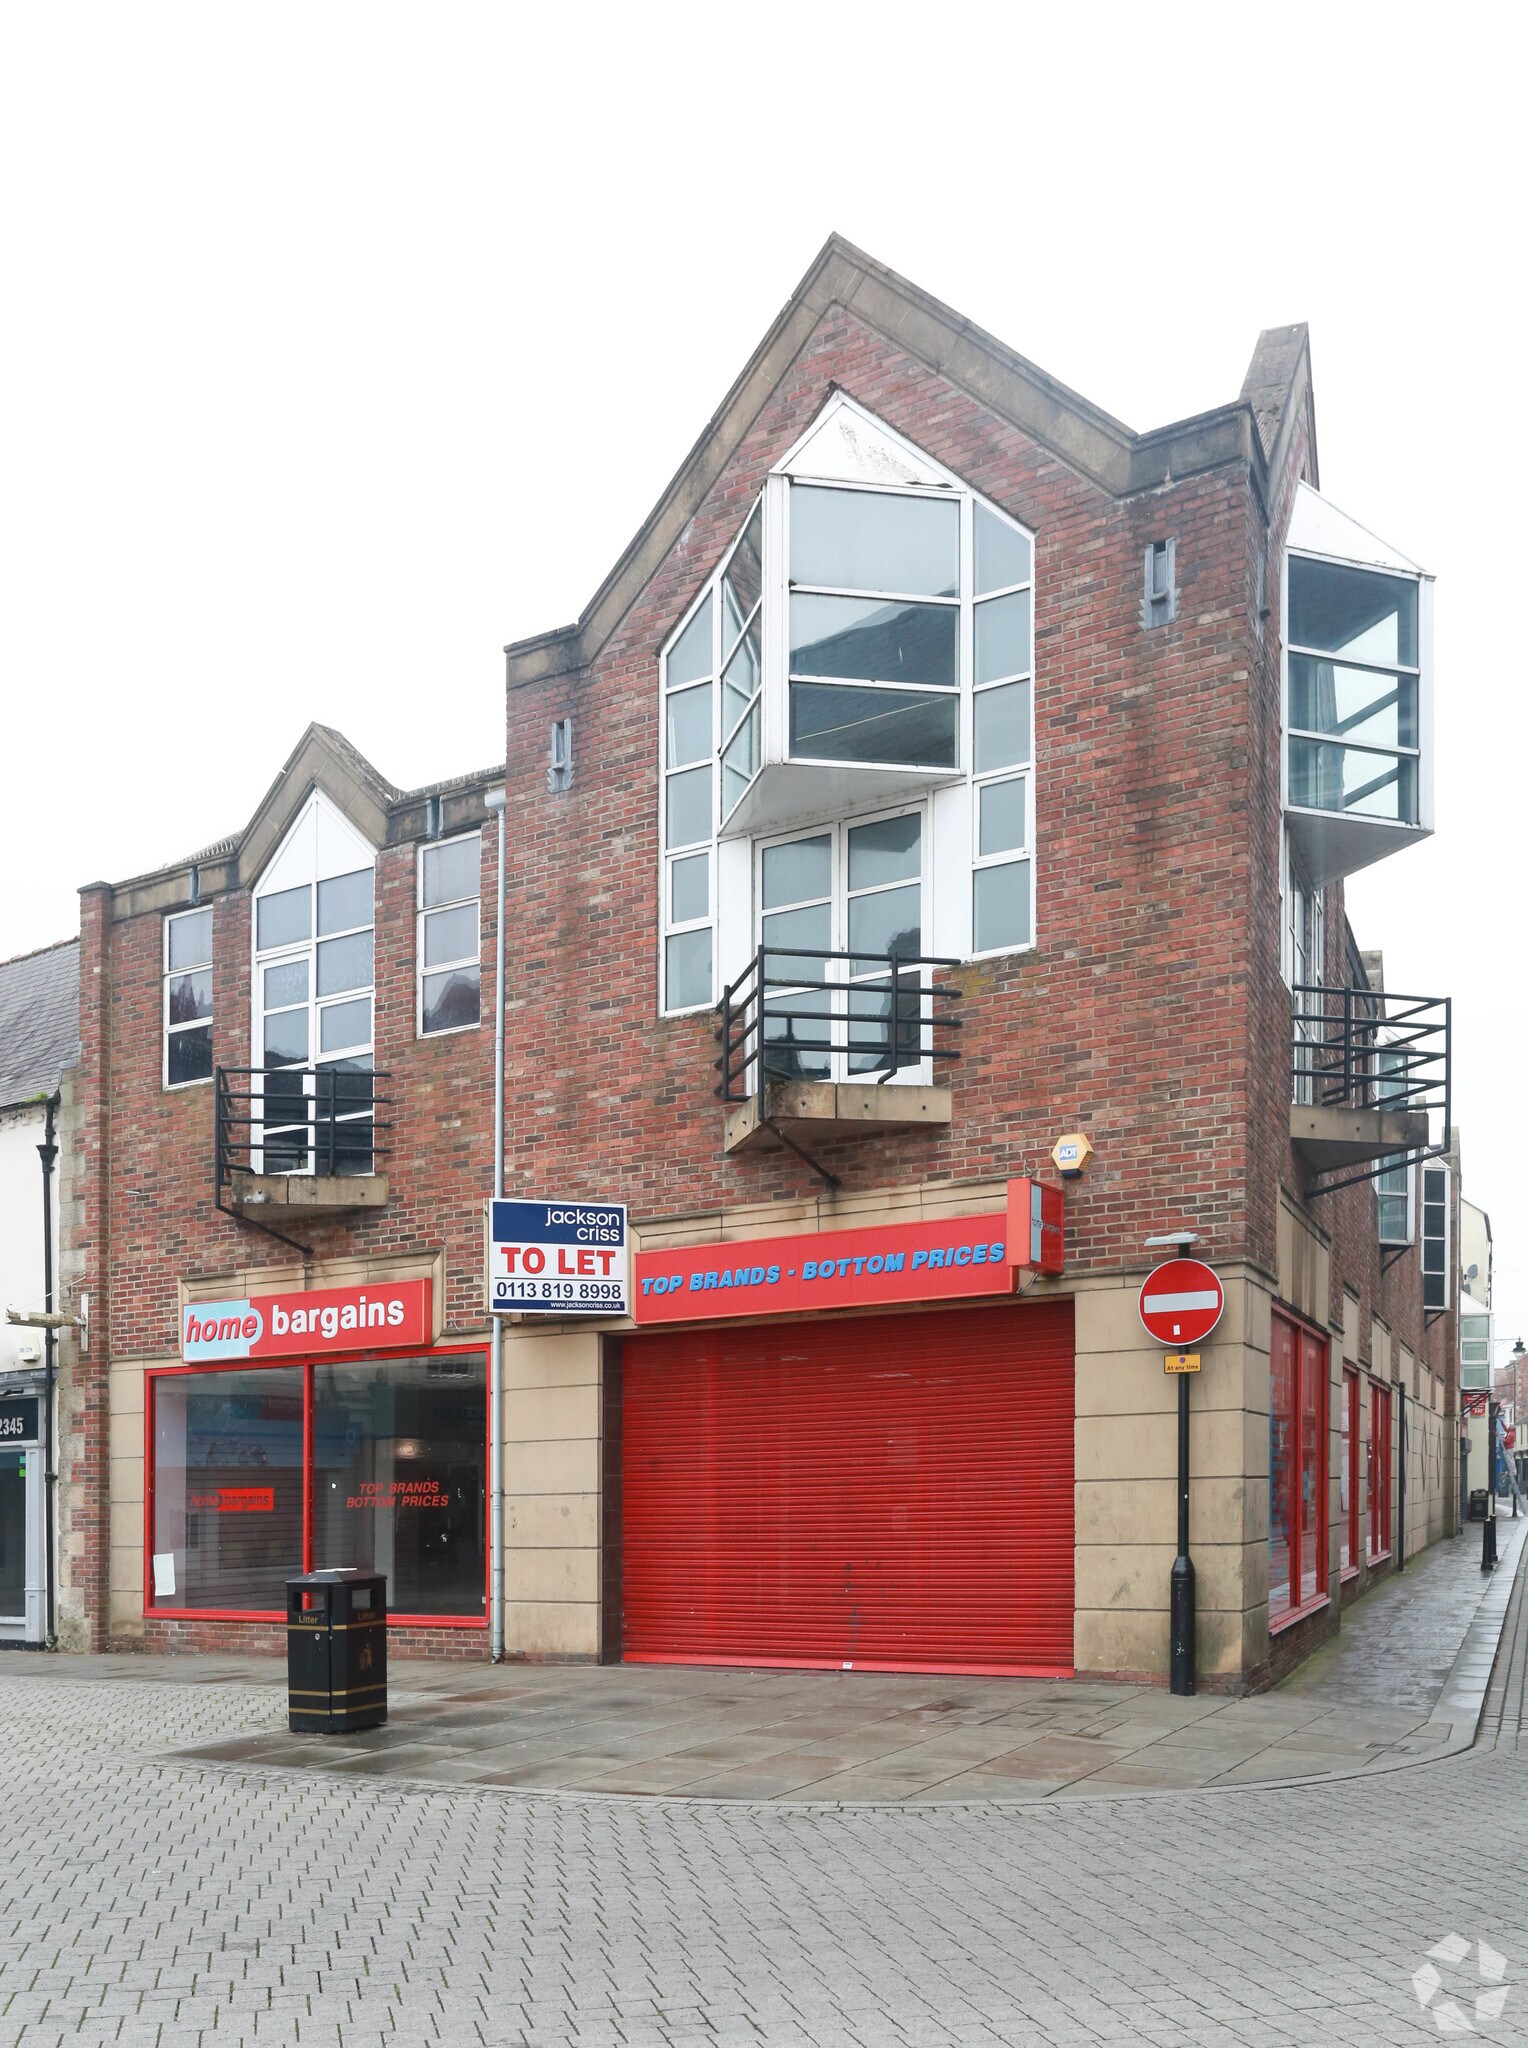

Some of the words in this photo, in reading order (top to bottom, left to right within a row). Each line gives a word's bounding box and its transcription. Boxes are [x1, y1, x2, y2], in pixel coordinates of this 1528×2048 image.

[1060, 1147, 1077, 1157] ADT
[545, 1207, 620, 1226] jackson
[576, 1225, 620, 1242] criss
[500, 1246, 546, 1275] TO
[558, 1248, 616, 1276] LET
[641, 1275, 684, 1296] TOP
[689, 1265, 781, 1292] BRANDS
[802, 1252, 905, 1281] BOTTOM
[911, 1242, 1006, 1271] PRICES
[496, 1281, 537, 1298] 0113
[542, 1282, 574, 1299] 819
[579, 1284, 621, 1300] 8998
[550, 1301, 621, 1309] www.jacksoncriss.co.uk
[185, 1312, 258, 1343] home
[272, 1296, 404, 1339] bargains
[360, 1482, 384, 1494] TOP
[389, 1481, 439, 1494] BRANDS
[222, 1493, 269, 1509] bargains
[346, 1495, 396, 1508] BOTTOM
[401, 1494, 449, 1507] PRICES
[298, 1615, 318, 1624] Litter
[358, 1611, 377, 1622] Litter
